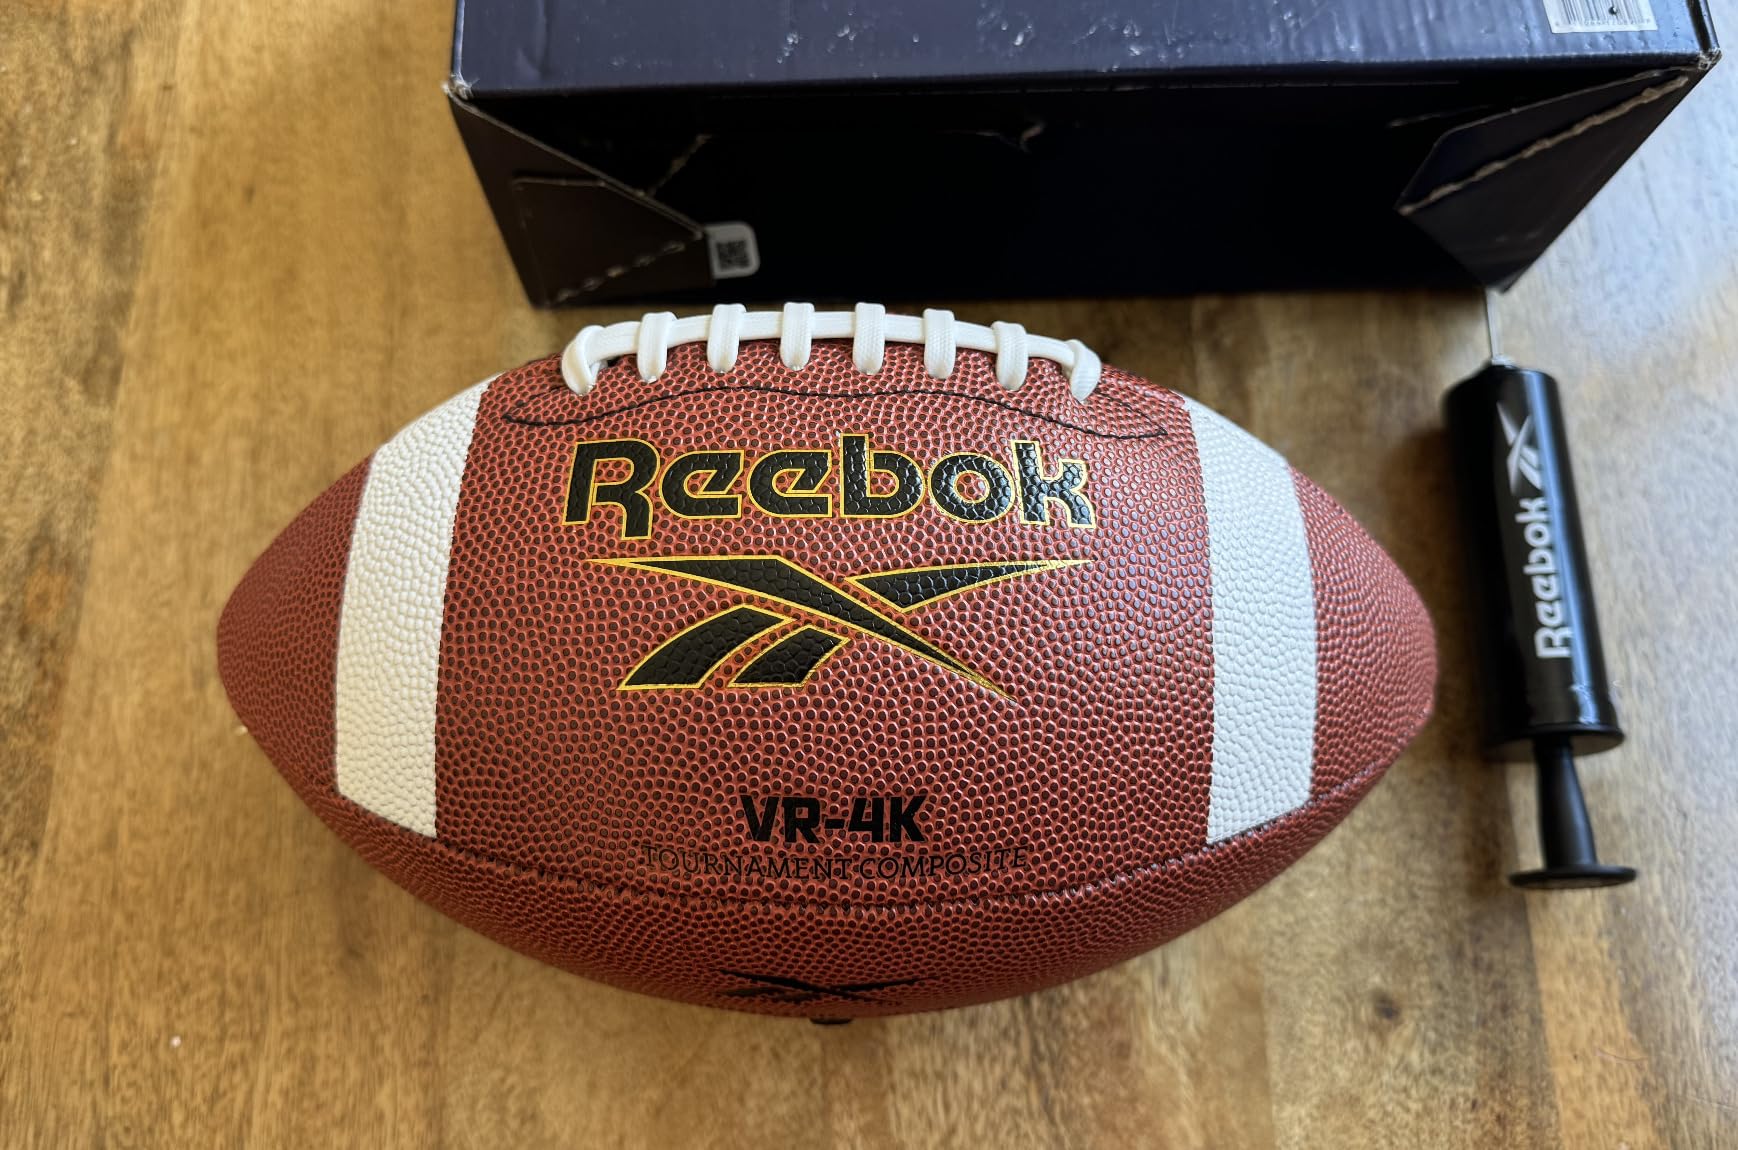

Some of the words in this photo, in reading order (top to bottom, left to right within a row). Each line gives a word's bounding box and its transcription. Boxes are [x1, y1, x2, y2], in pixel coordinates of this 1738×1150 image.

[562, 433, 1097, 540] Reebok
[1515, 497, 1574, 659] Reebok
[740, 794, 928, 844] VR-4K
[642, 844, 852, 880] TOURNAMENT
[859, 846, 1029, 879] COMPOSITE
